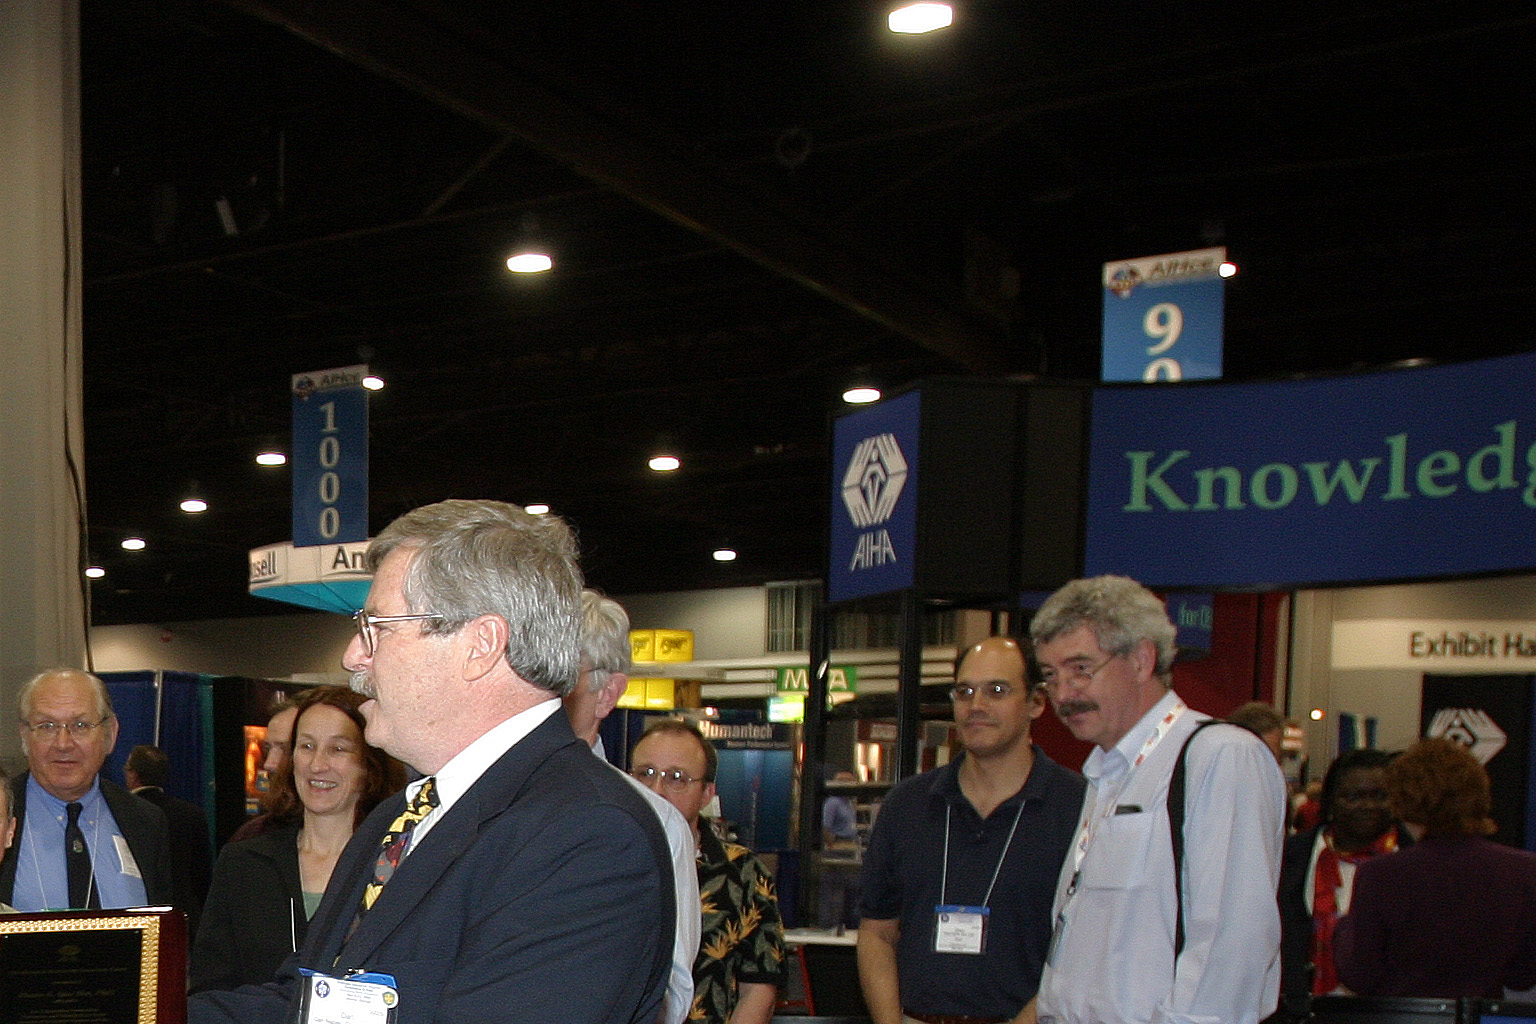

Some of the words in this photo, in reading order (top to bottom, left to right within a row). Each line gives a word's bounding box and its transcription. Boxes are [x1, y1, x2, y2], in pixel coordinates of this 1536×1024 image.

[319, 401, 341, 540] 1000
[850, 528, 897, 572] AIHA
[1409, 630, 1496, 658] Exhibit
[783, 667, 849, 690] MA
[698, 720, 773, 740] Humantech
